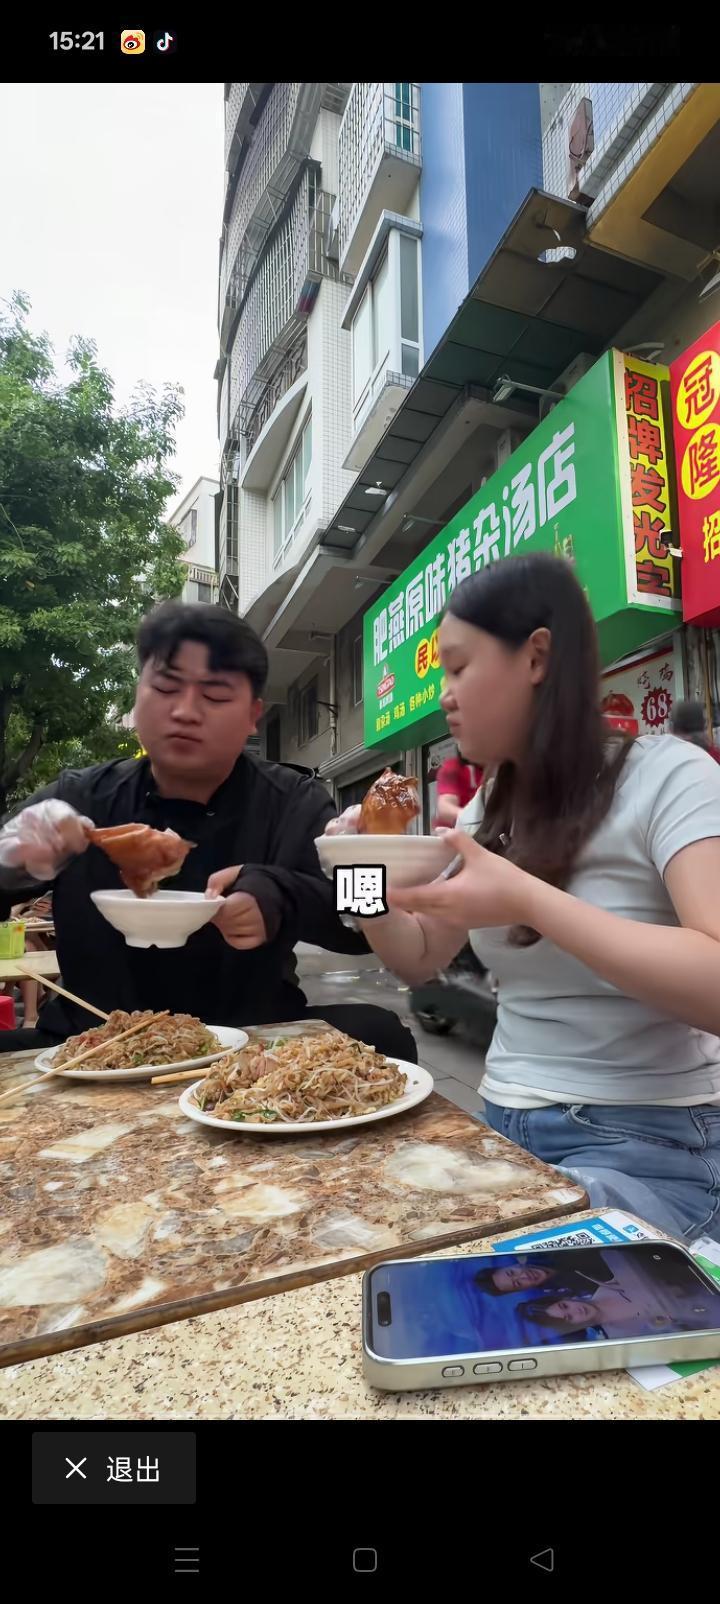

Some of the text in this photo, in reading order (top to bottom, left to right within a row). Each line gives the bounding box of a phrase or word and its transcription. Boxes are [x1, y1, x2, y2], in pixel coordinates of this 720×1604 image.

[625, 368, 672, 597] 招牌发光字
[684, 356, 720, 496] 冠隆
[373, 422, 577, 667] 肥燕原味猪杂汤店
[646, 693, 668, 721] 68
